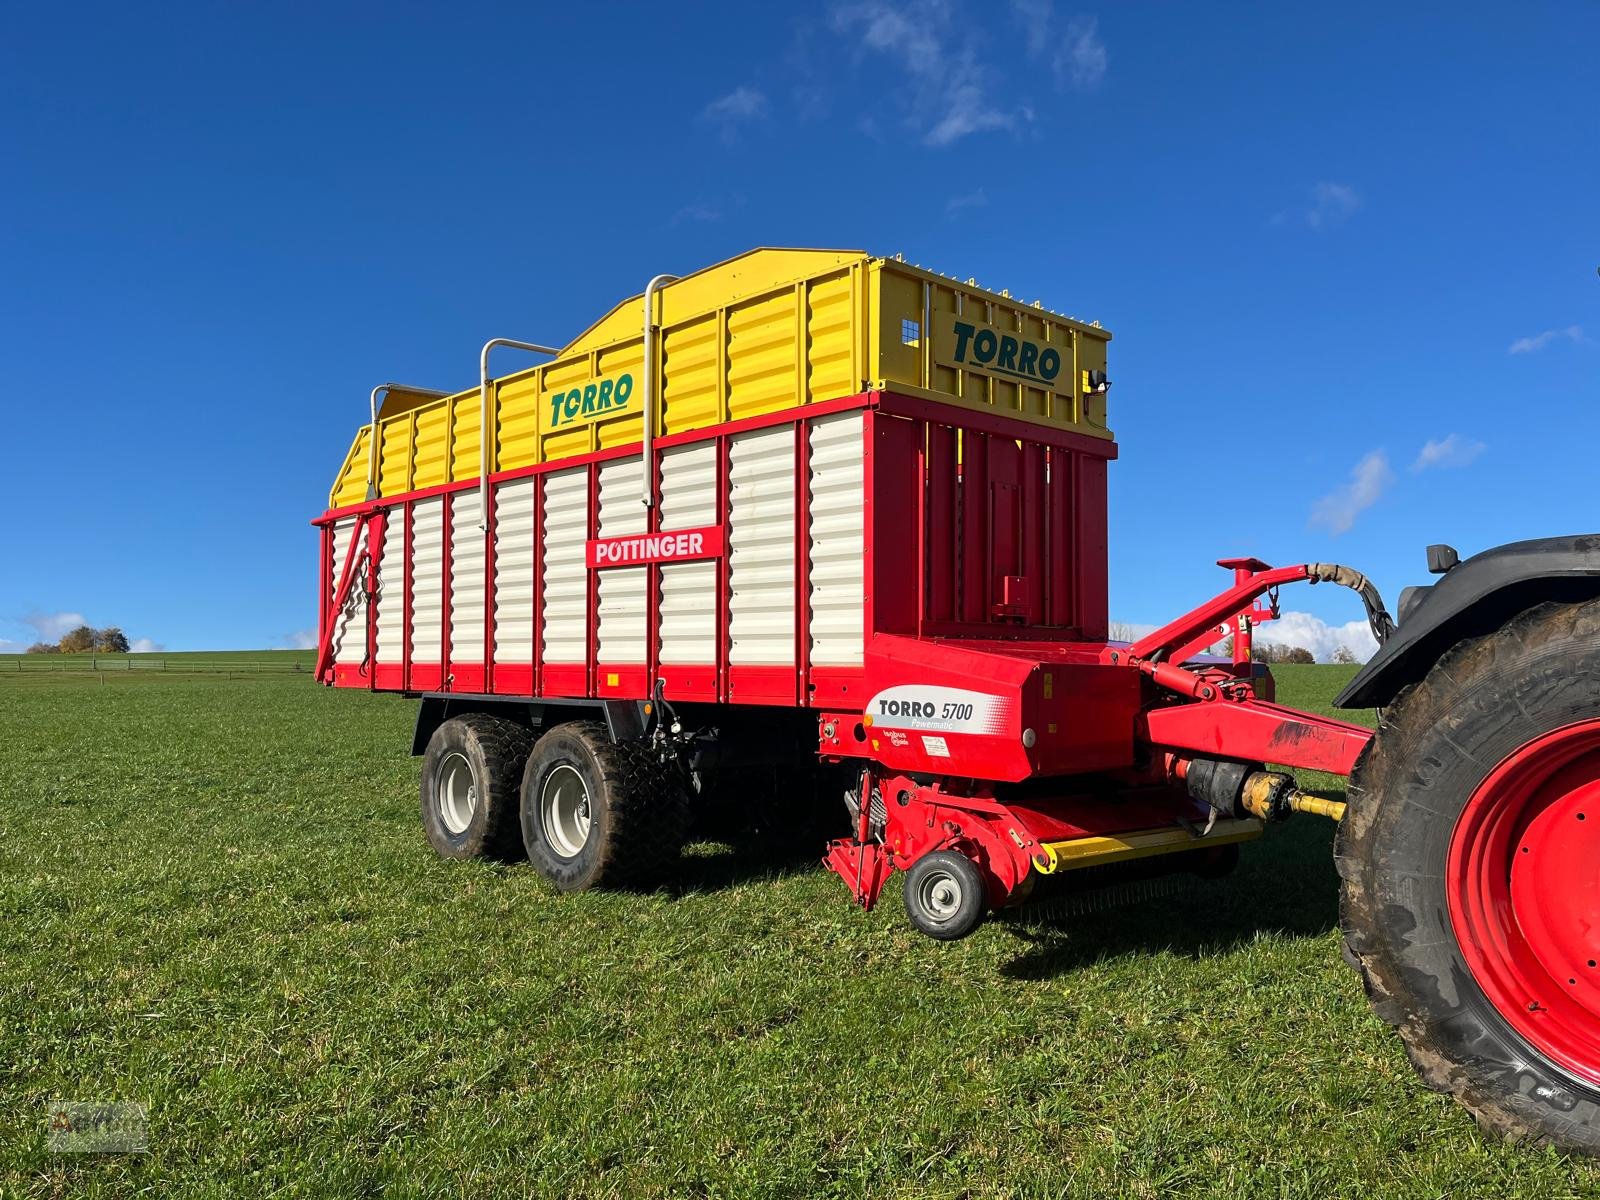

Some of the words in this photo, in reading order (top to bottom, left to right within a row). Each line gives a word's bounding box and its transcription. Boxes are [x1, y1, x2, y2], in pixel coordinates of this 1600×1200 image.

[953, 321, 1061, 380] TORRO
[551, 373, 633, 427] TORRO
[879, 700, 936, 718] TORRO
[941, 703, 973, 721] 5700
[911, 718, 953, 730] Powermatic
